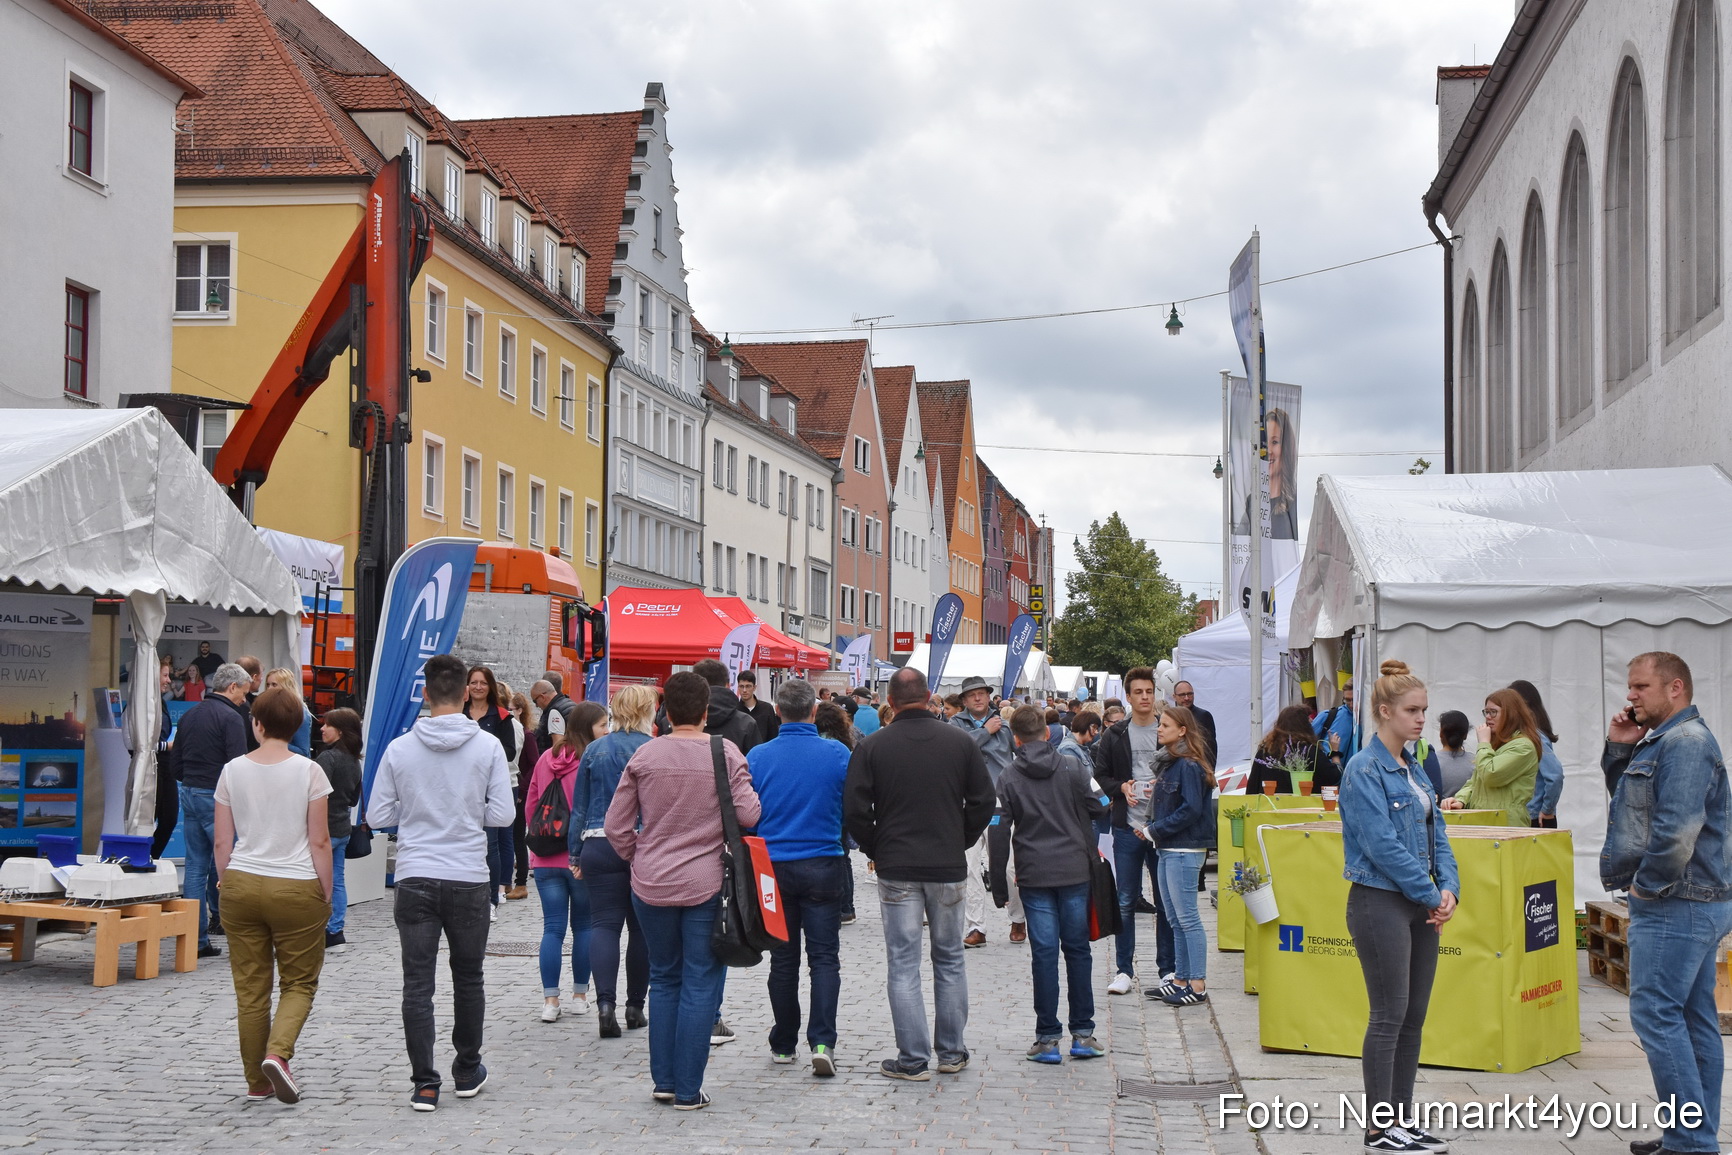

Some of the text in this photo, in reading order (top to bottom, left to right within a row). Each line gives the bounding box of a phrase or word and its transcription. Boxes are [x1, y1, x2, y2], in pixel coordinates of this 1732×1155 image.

[291, 565, 328, 583] RAIL.ONE
[636, 603, 681, 613] Petry
[941, 602, 956, 634] Fischer
[1016, 621, 1030, 650] Fischer
[15, 668, 49, 682] WAY.
[1530, 902, 1554, 918] Fischer
[1307, 947, 1336, 956] GEORG
[1520, 979, 1563, 1003] HAMMERBACHER
